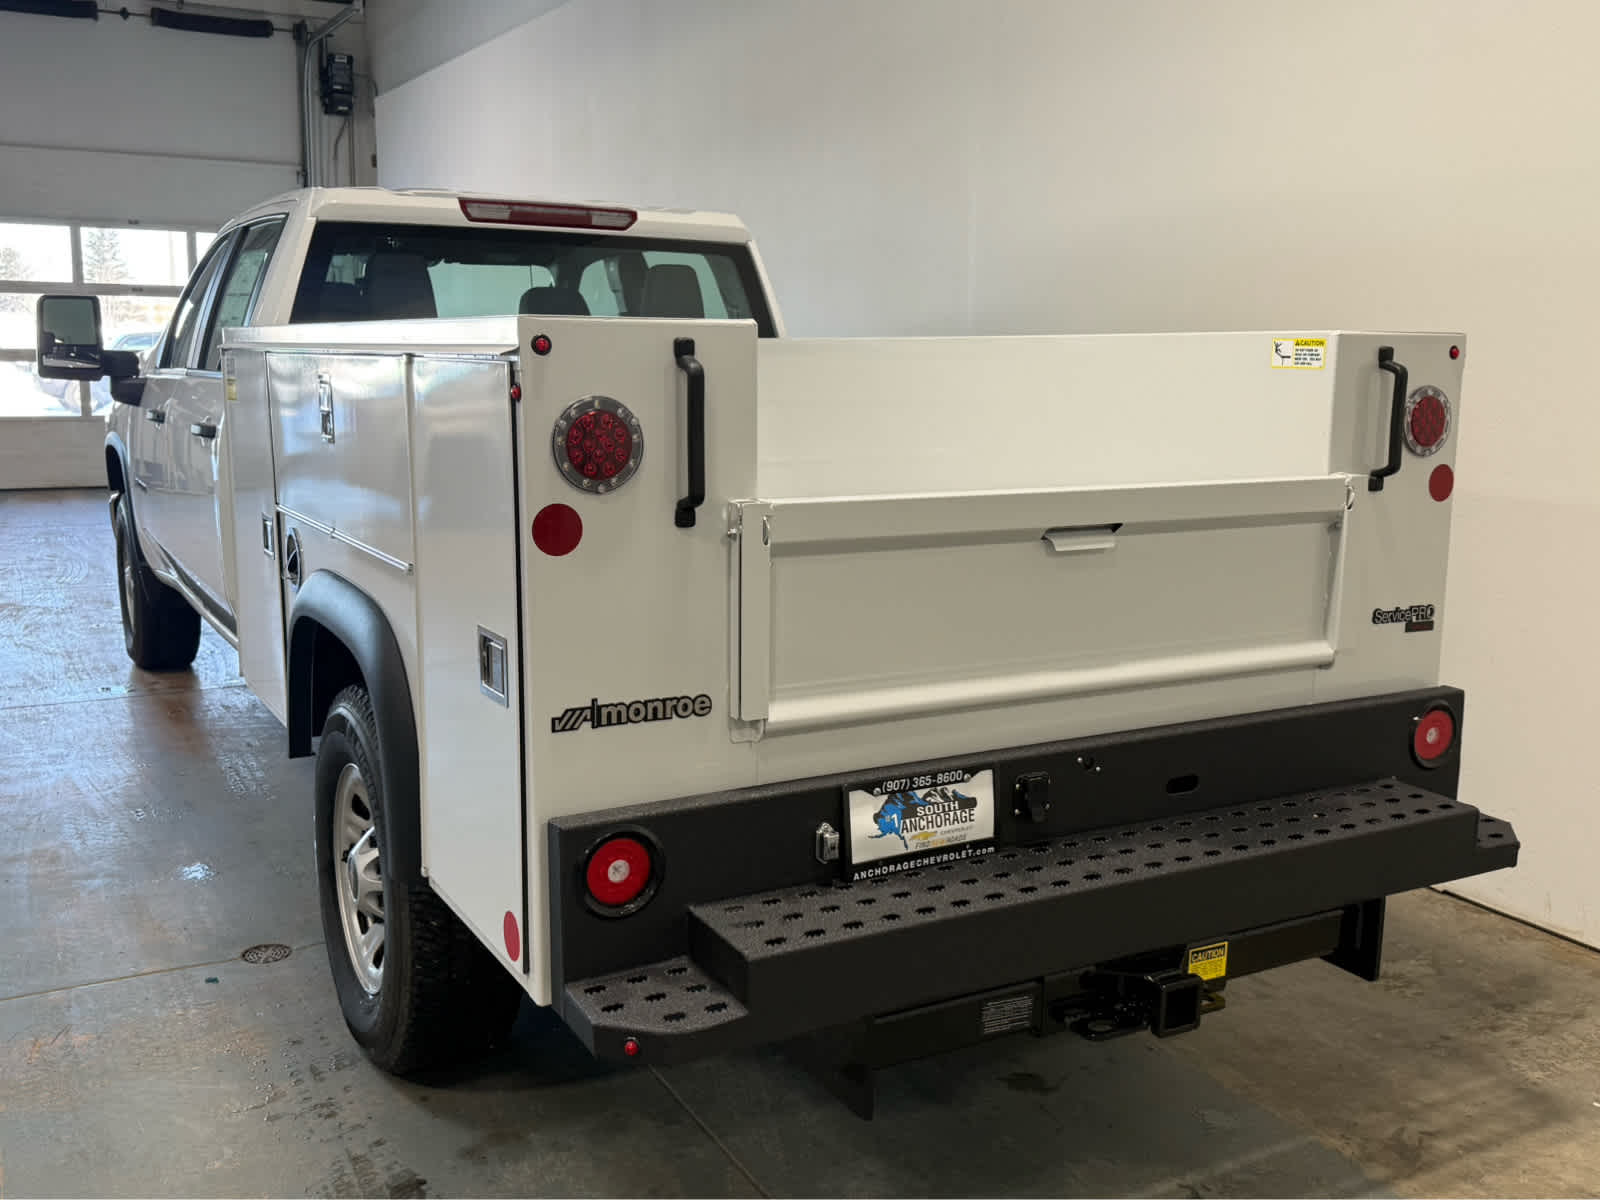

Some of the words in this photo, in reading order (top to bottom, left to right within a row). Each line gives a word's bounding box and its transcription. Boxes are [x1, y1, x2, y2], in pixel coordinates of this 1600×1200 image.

[1301, 338, 1325, 346] CAUTION
[1372, 604, 1434, 624] ServicePRO
[601, 694, 712, 726] monroe
[882, 777, 910, 793] (907)
[912, 770, 963, 788] 365-8600
[916, 801, 960, 816] SOUTH
[901, 809, 975, 833] ANCHORAGE
[853, 847, 995, 881] ANCHORAGECHEVROLET.com
[1191, 947, 1225, 964] CAUTION
